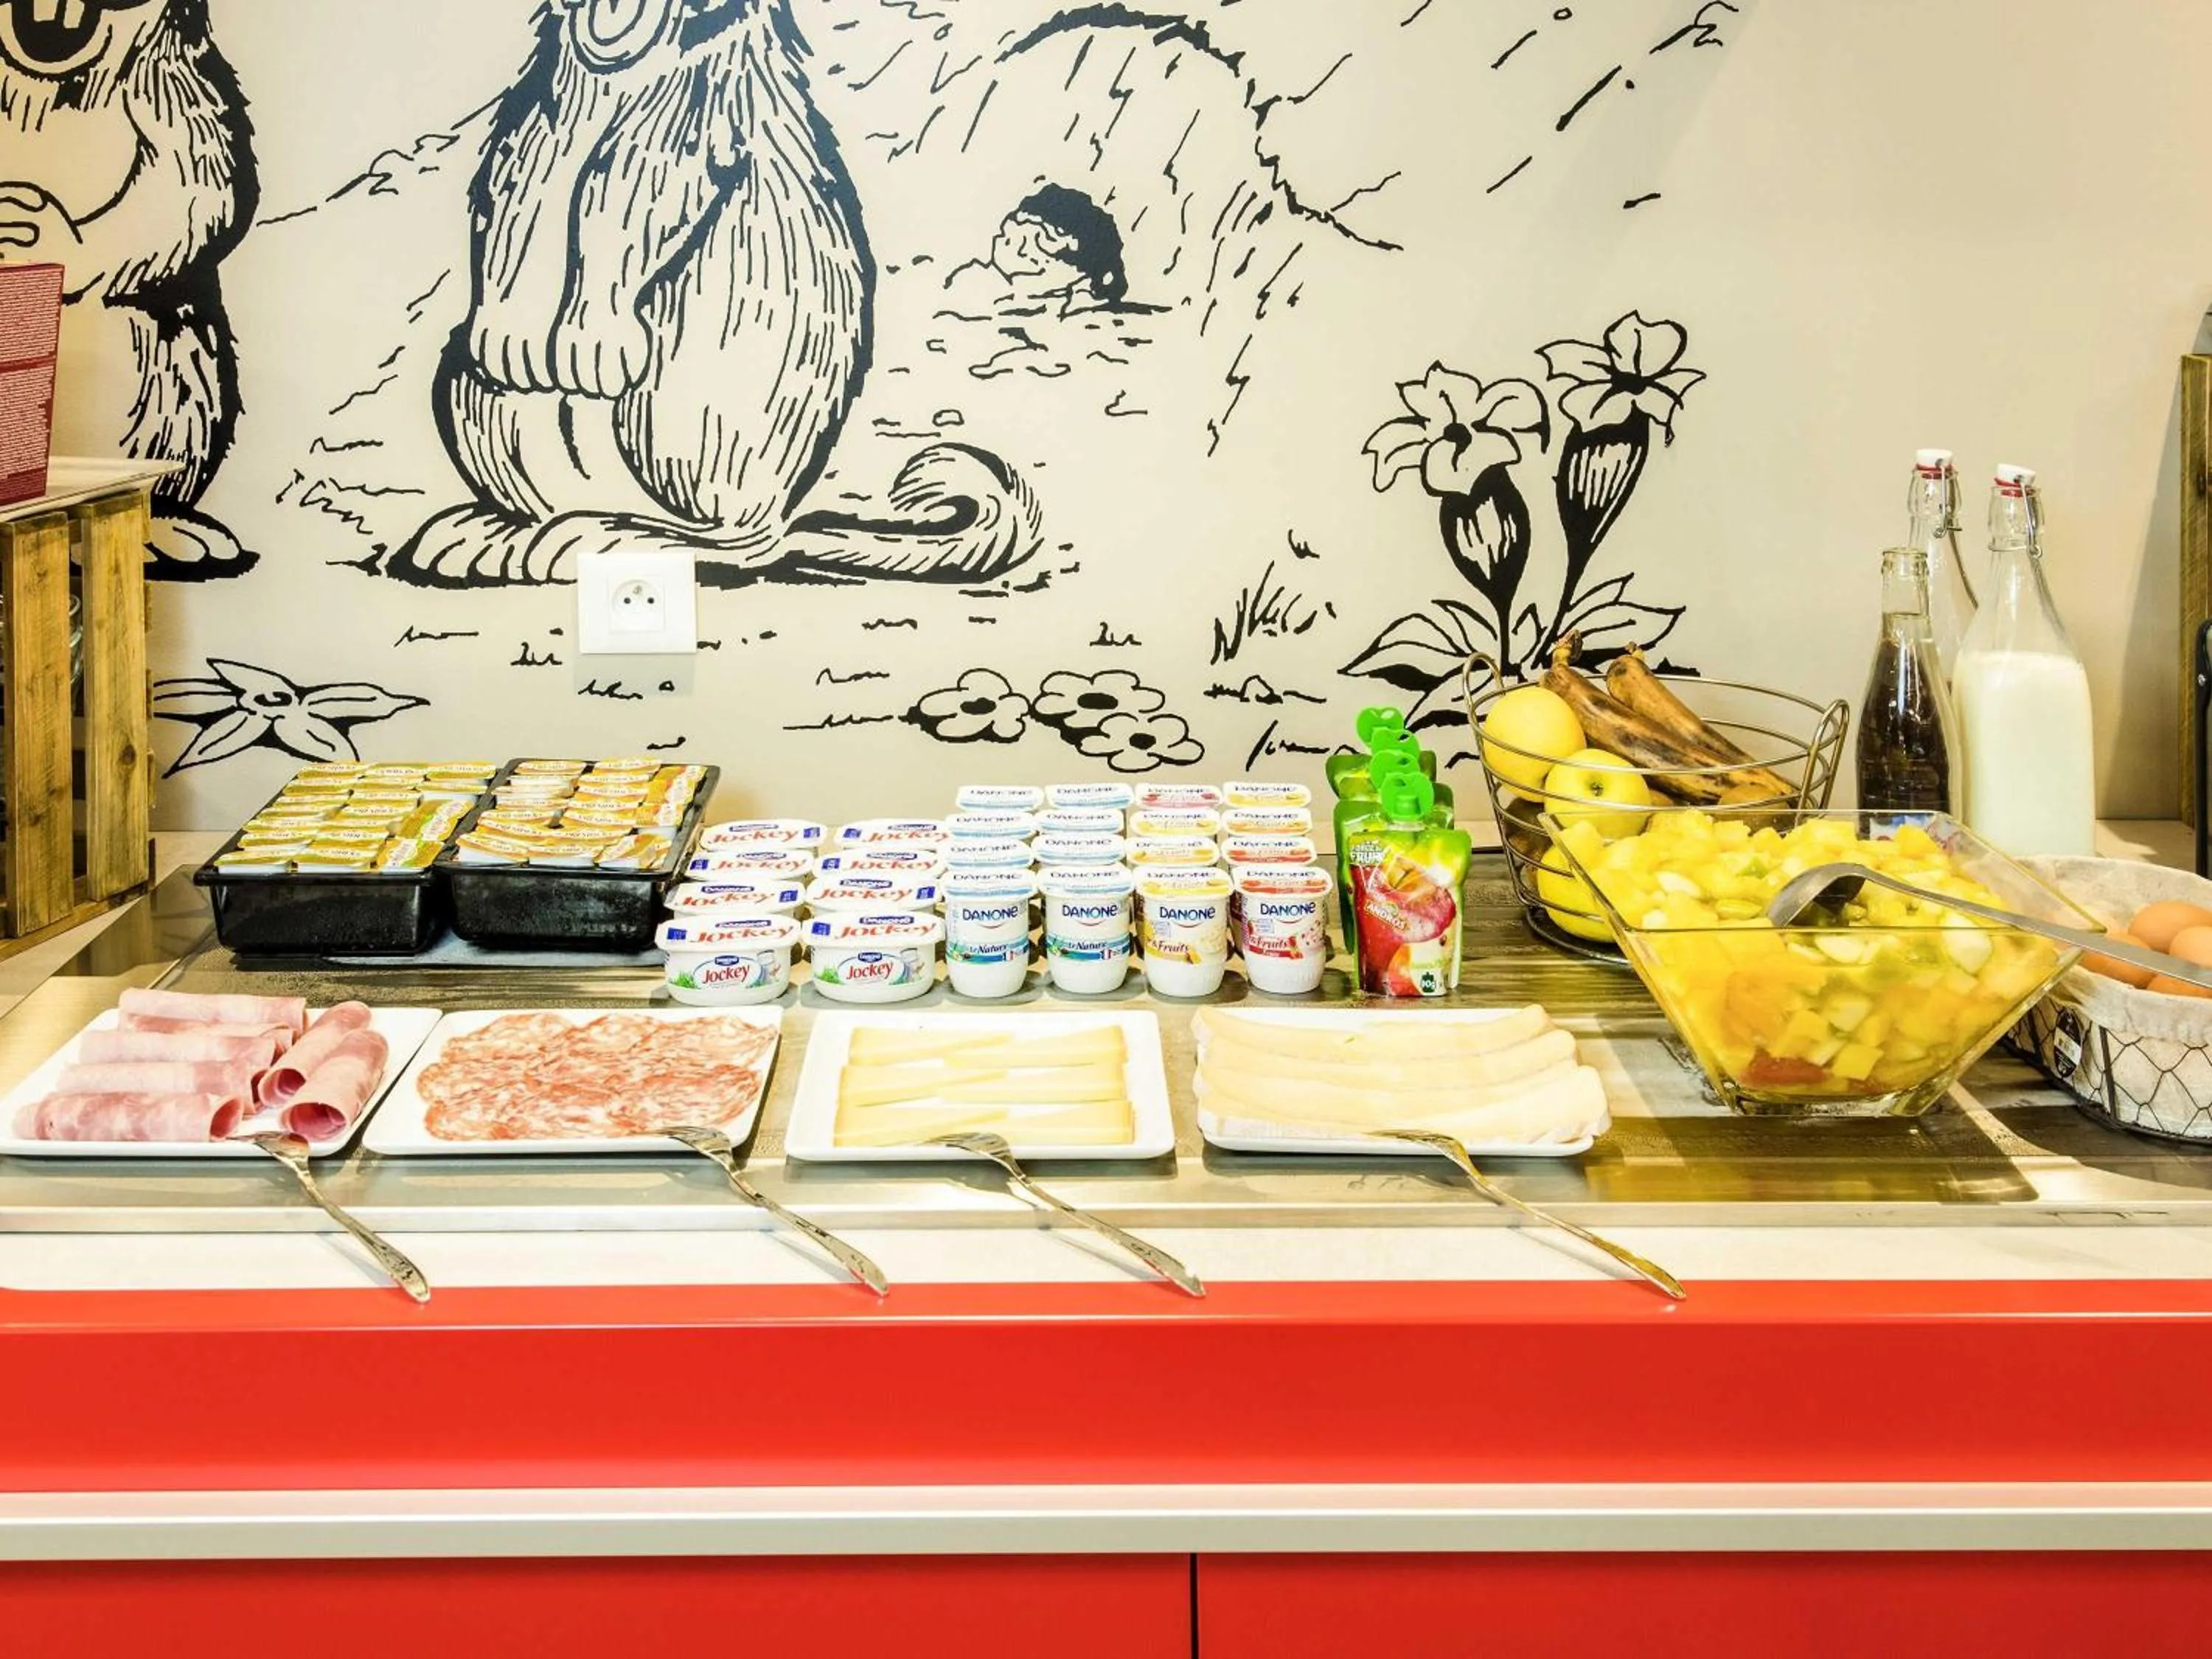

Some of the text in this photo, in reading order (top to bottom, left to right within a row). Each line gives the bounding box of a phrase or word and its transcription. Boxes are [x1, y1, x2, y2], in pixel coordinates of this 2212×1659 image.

[708, 830, 799, 844] Jockey
[862, 831, 949, 842] Jockey
[845, 860, 938, 871] Jockey
[676, 893, 775, 905] Jockey
[813, 889, 913, 901] Jockey
[962, 905, 1018, 921] DANONE
[1062, 904, 1118, 919] DANONE
[1160, 906, 1215, 921] DANONE
[1260, 902, 1315, 917] DANONE
[1368, 903, 1408, 931] ANDROS
[690, 926, 794, 943] Jockey
[835, 923, 936, 939] Jockey
[1158, 941, 1189, 953] Fruits
[702, 964, 750, 984] Jockey
[846, 961, 894, 981] Jockey
